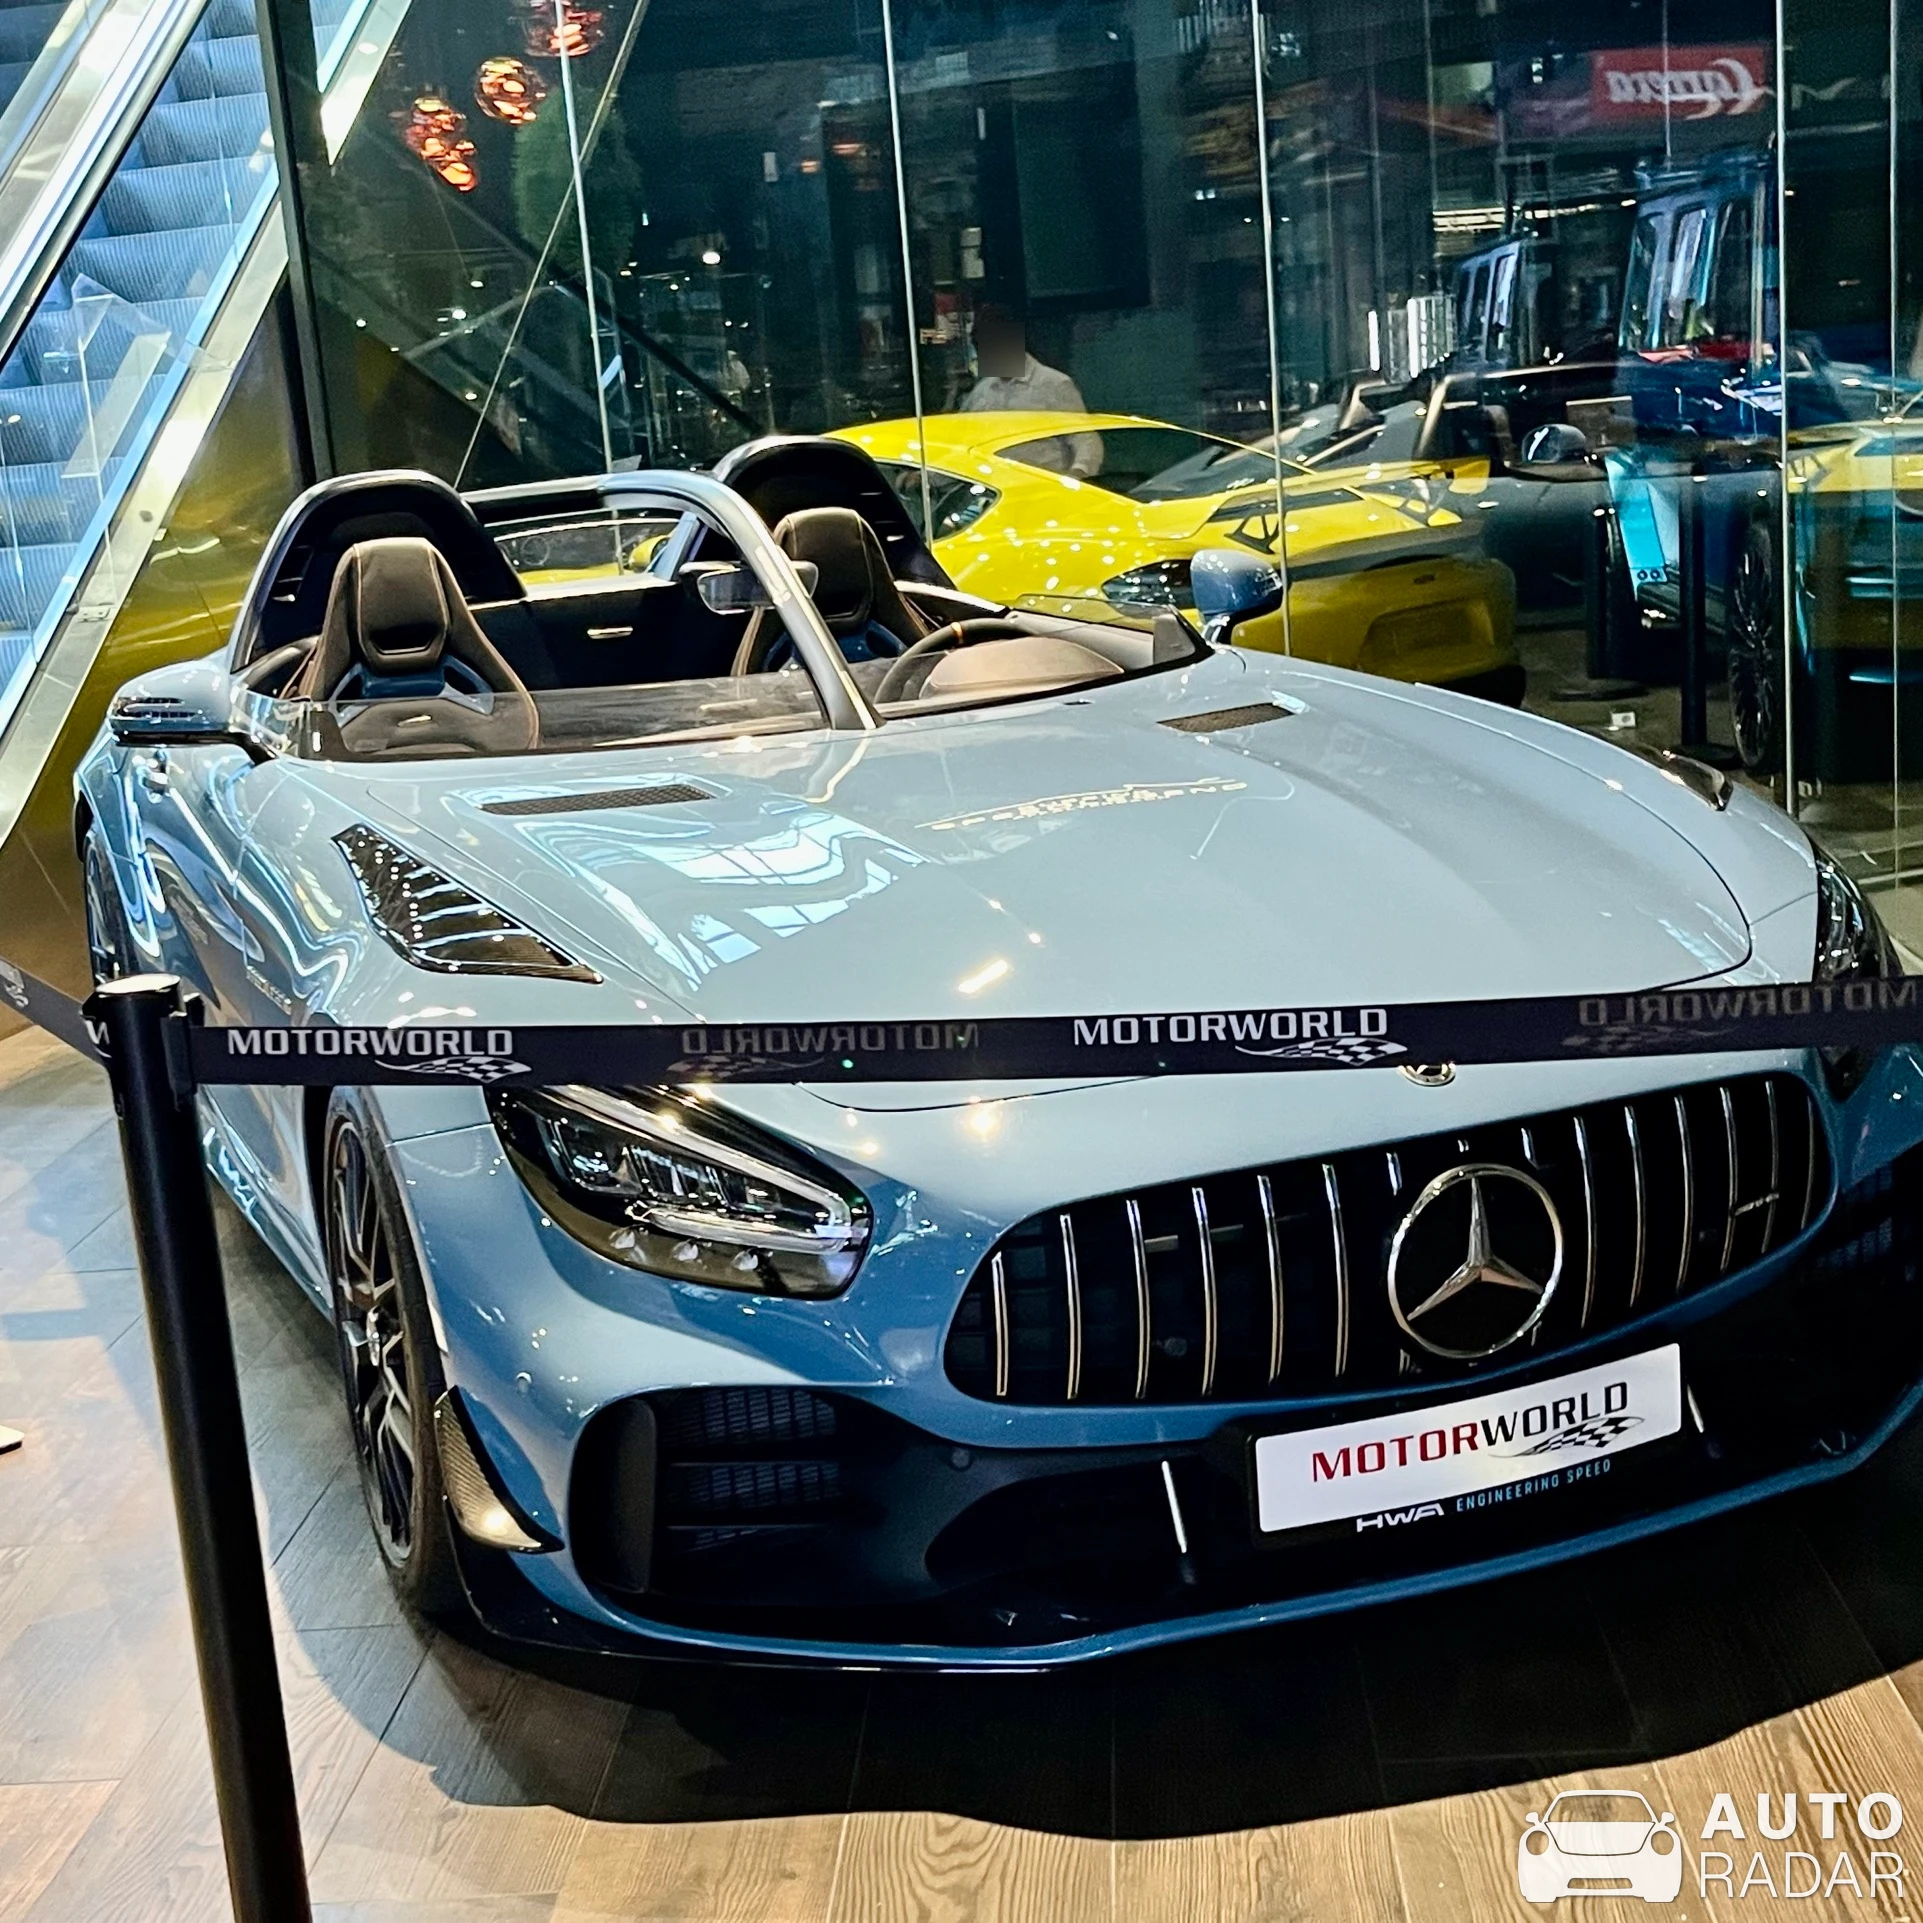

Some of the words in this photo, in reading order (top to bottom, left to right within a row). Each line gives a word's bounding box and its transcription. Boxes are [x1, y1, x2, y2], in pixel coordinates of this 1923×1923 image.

[227, 1029, 513, 1056] MOTORWORLD
[1073, 1008, 1388, 1046] MOTORWORLD
[1312, 1381, 1628, 1483] MOTORWORLD
[1355, 1502, 1445, 1533] HWA
[1456, 1473, 1560, 1513] ENGINEERING
[1566, 1458, 1612, 1484] SPEED
